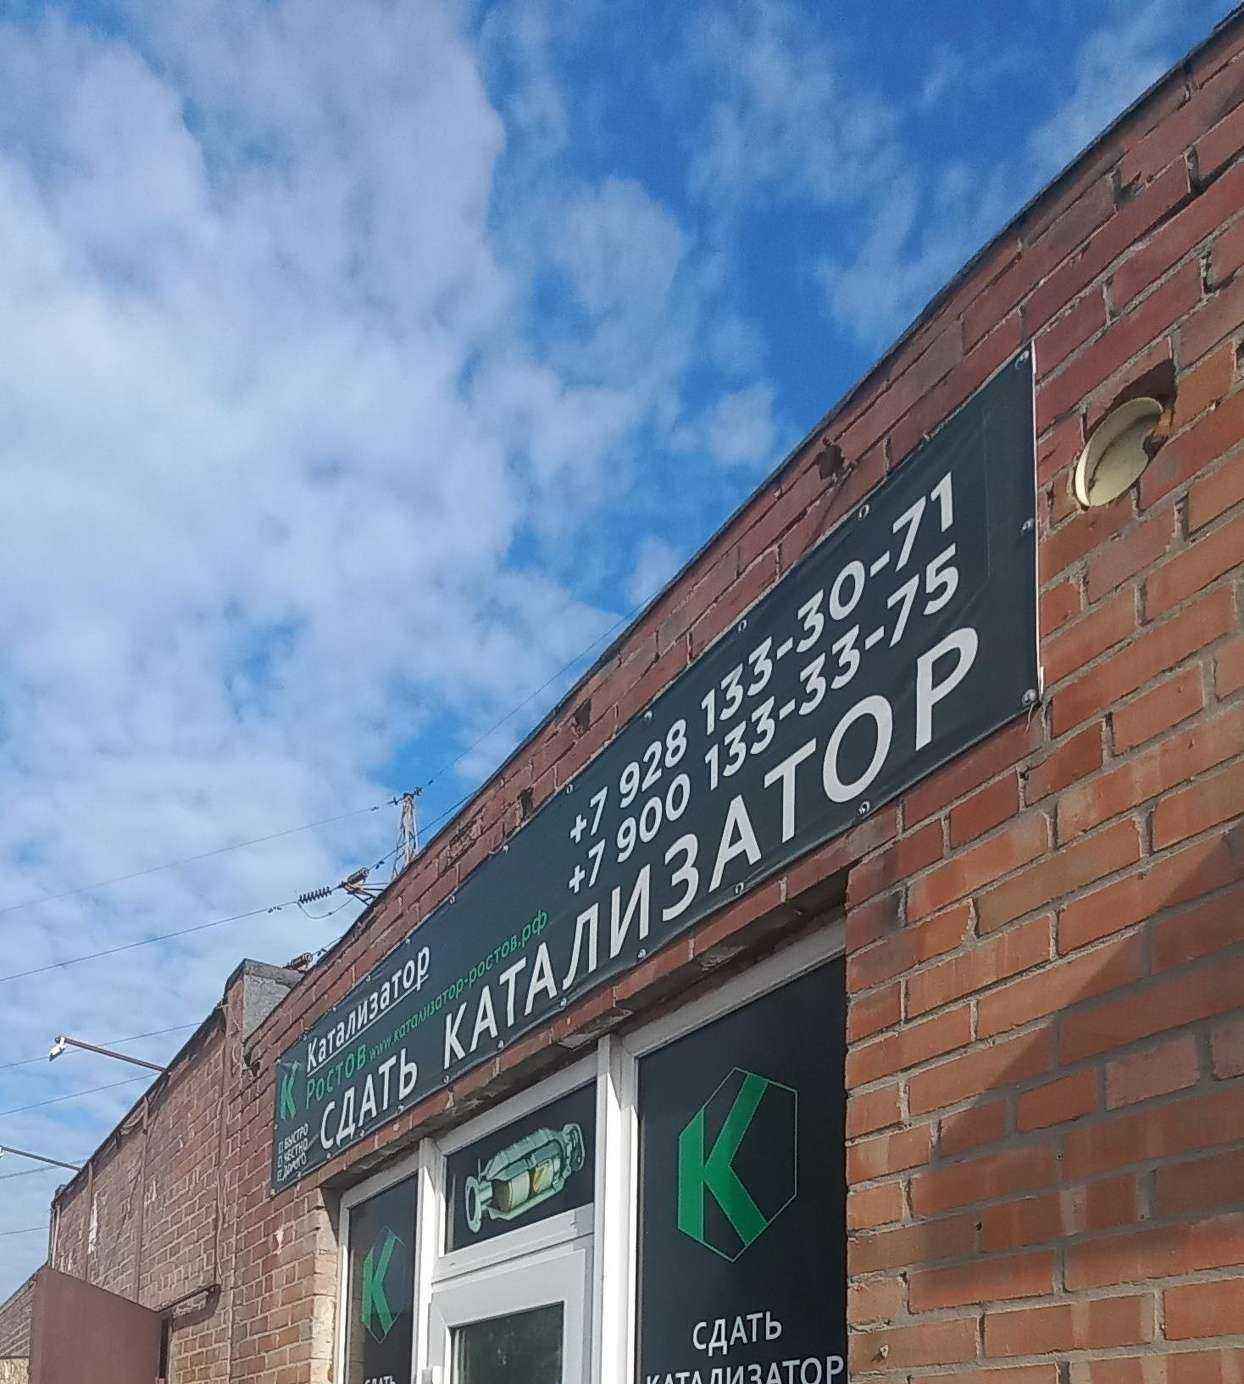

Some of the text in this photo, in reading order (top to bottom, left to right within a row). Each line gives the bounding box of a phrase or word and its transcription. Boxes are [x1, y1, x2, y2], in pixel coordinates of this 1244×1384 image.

[568, 542, 960, 895] +7 900 133-33-75
[569, 471, 955, 844] +7 928 133-30-71
[306, 945, 431, 1074] Катализатор
[320, 627, 979, 1151] СДАТЬ КАТАЛИЗАТОР
[692, 1311, 782, 1356] СДАТЬ
